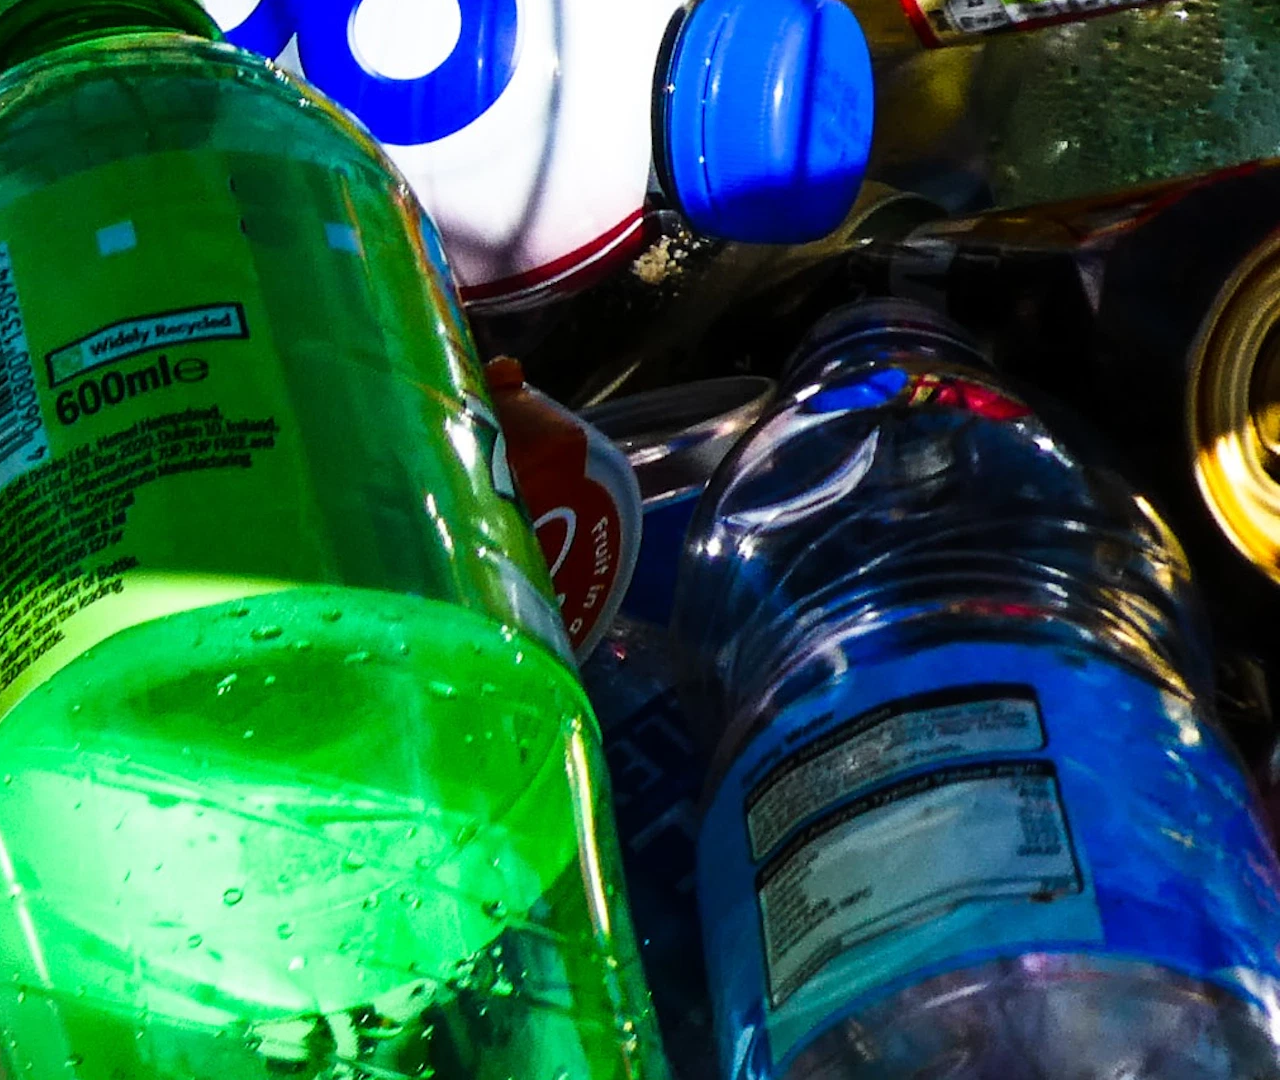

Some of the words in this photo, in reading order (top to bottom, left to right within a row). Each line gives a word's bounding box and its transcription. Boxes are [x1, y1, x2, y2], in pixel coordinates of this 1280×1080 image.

[88, 324, 153, 359] Widely
[154, 310, 233, 342] Recycled
[54, 357, 174, 428] 600ml
[568, 617, 584, 636] a
